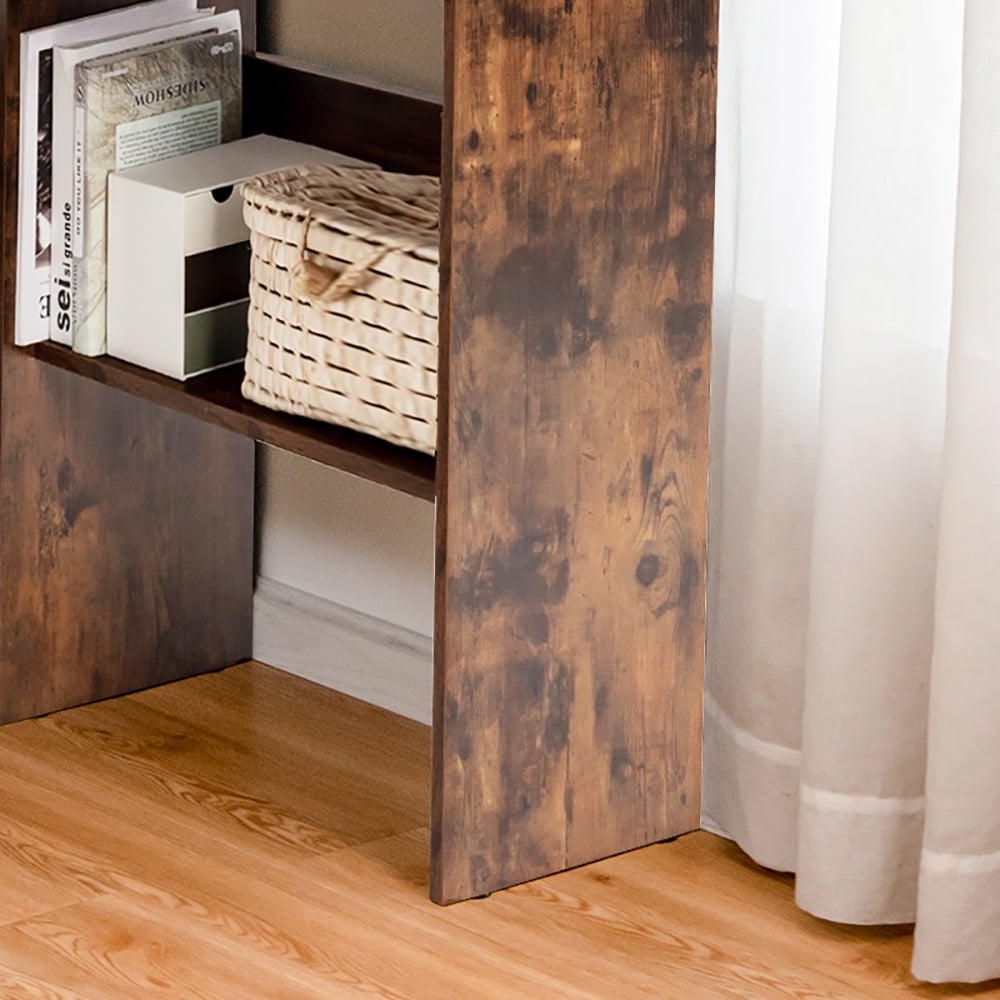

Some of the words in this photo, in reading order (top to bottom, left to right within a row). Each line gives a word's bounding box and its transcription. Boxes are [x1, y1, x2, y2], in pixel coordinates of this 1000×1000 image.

[134, 80, 206, 107] SIDESHOW
[62, 202, 74, 259] grande
[54, 277, 72, 332] sei
